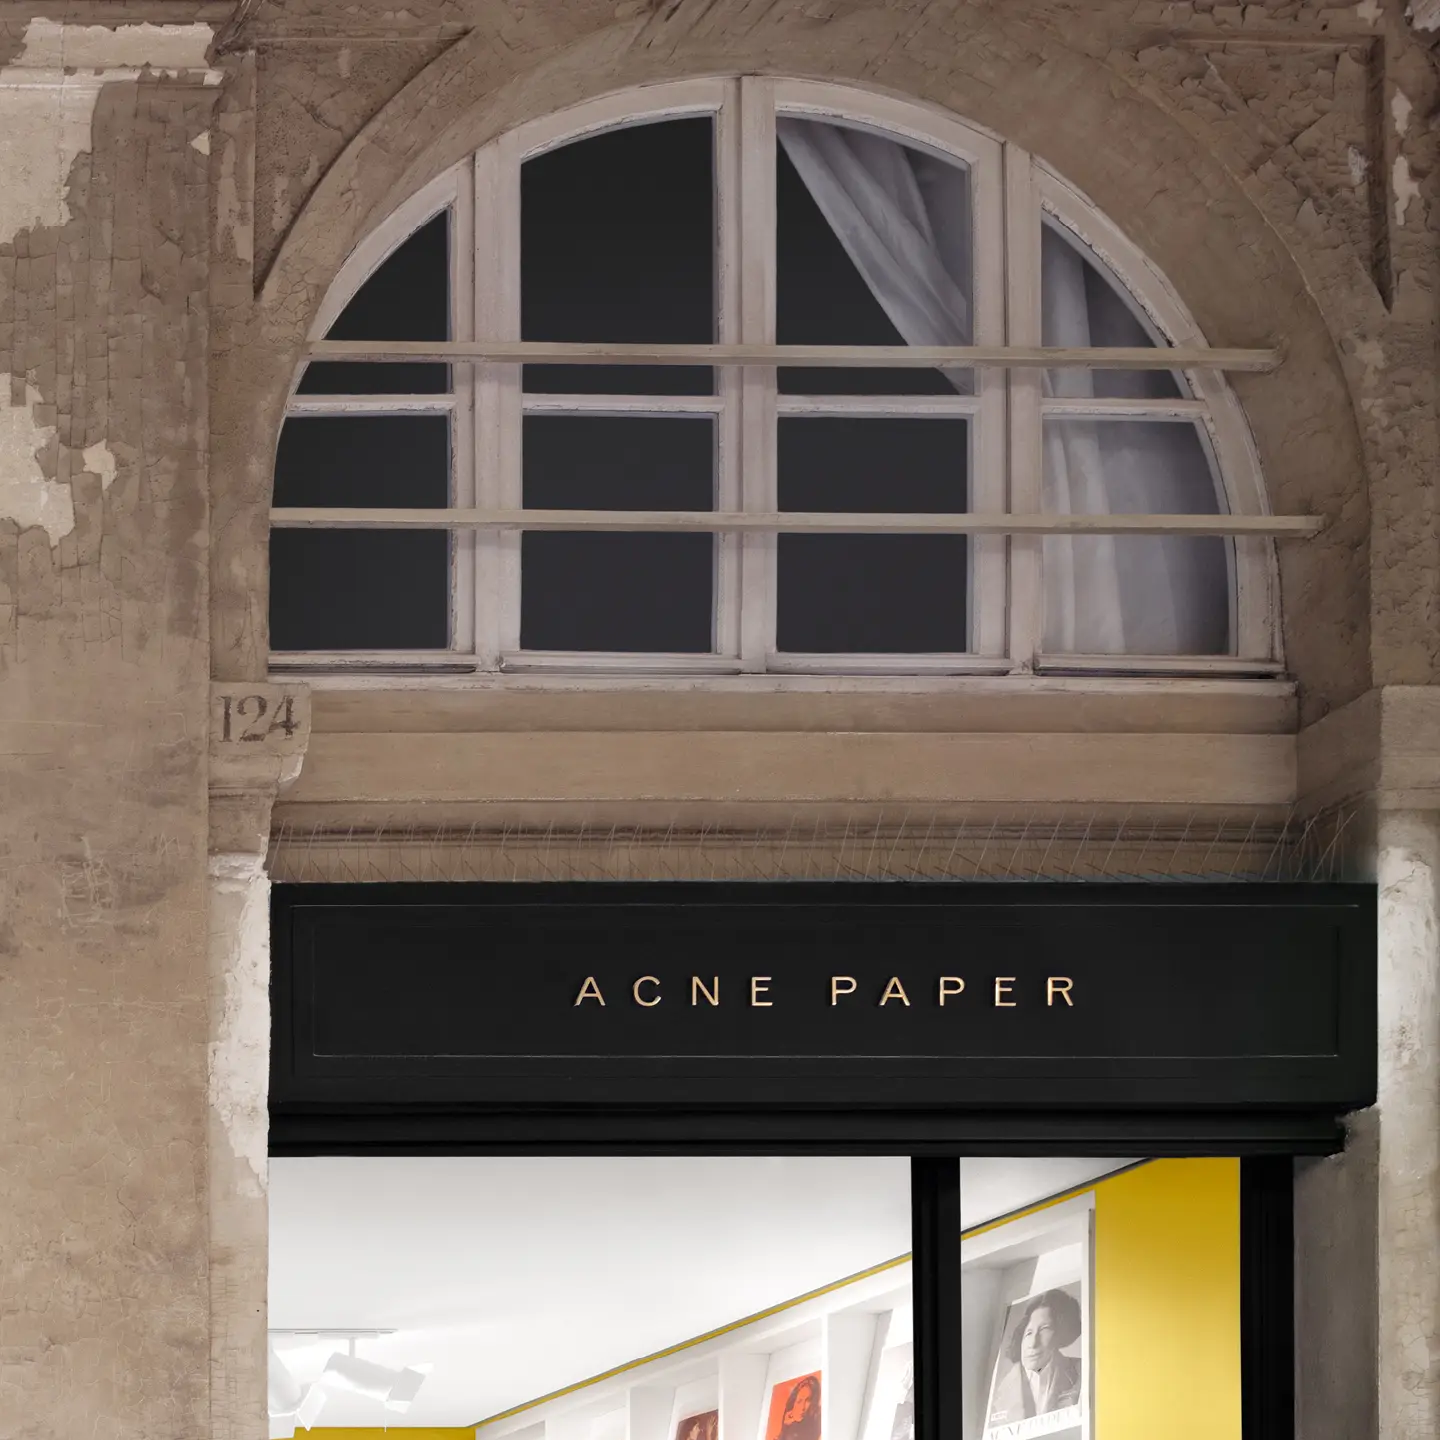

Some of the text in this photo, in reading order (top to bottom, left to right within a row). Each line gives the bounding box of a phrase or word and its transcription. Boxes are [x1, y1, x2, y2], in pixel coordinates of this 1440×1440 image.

[216, 694, 301, 743] 124
[573, 975, 1074, 1007] ACNE PAPER
